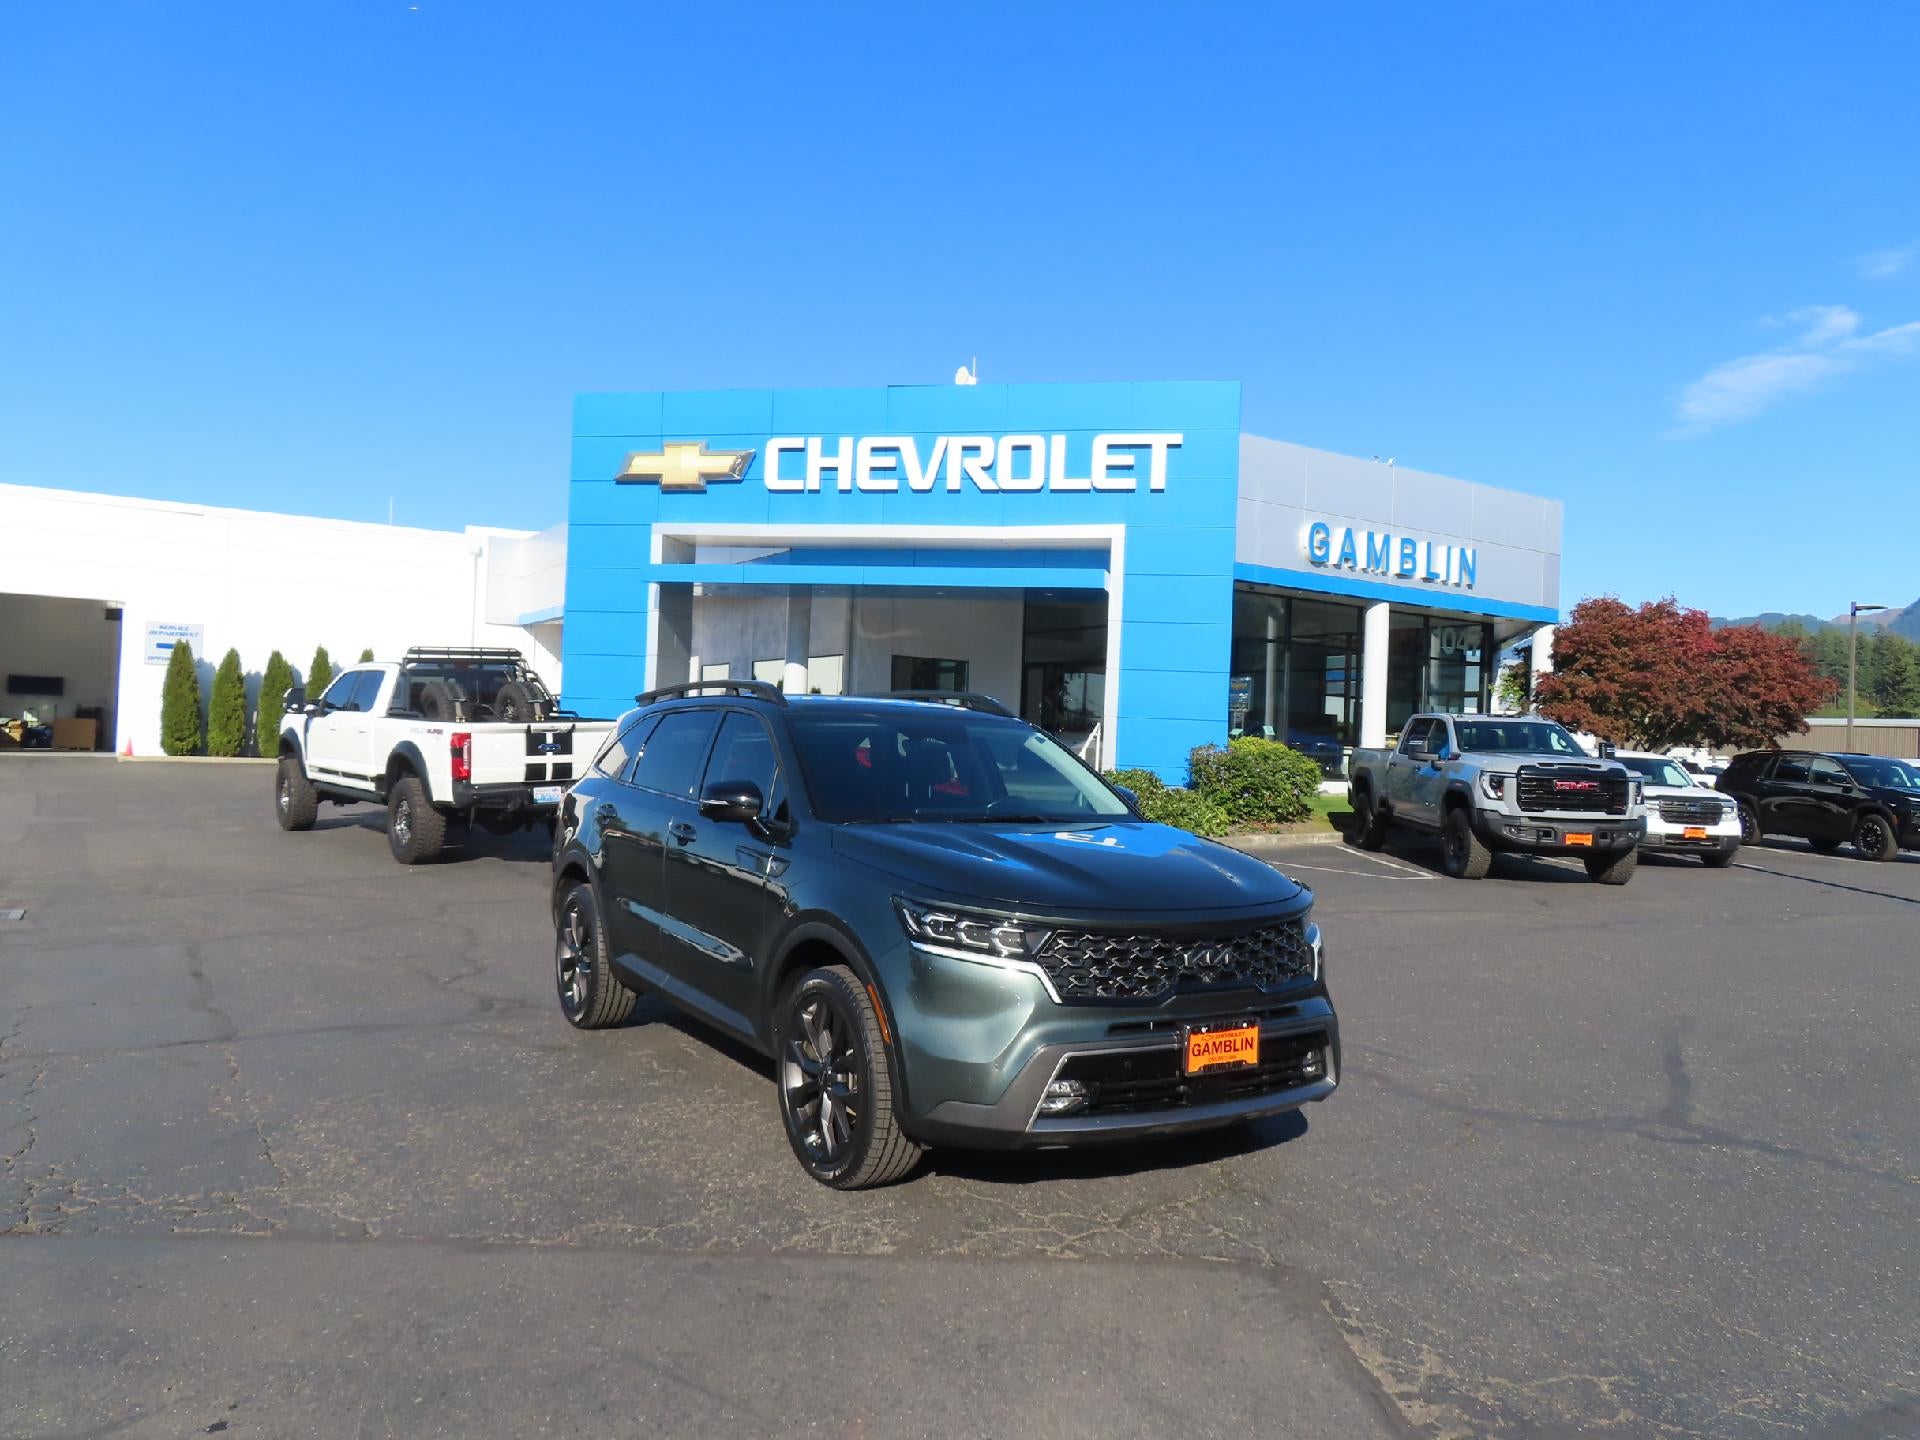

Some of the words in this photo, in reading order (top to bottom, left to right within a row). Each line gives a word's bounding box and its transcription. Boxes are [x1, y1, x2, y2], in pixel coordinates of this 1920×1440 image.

[763, 432, 1184, 494] CHEVROLET
[1308, 521, 1477, 586] GAMBLIN
[1554, 780, 1600, 792] GMC
[1191, 1036, 1255, 1057] GAMBLIN
